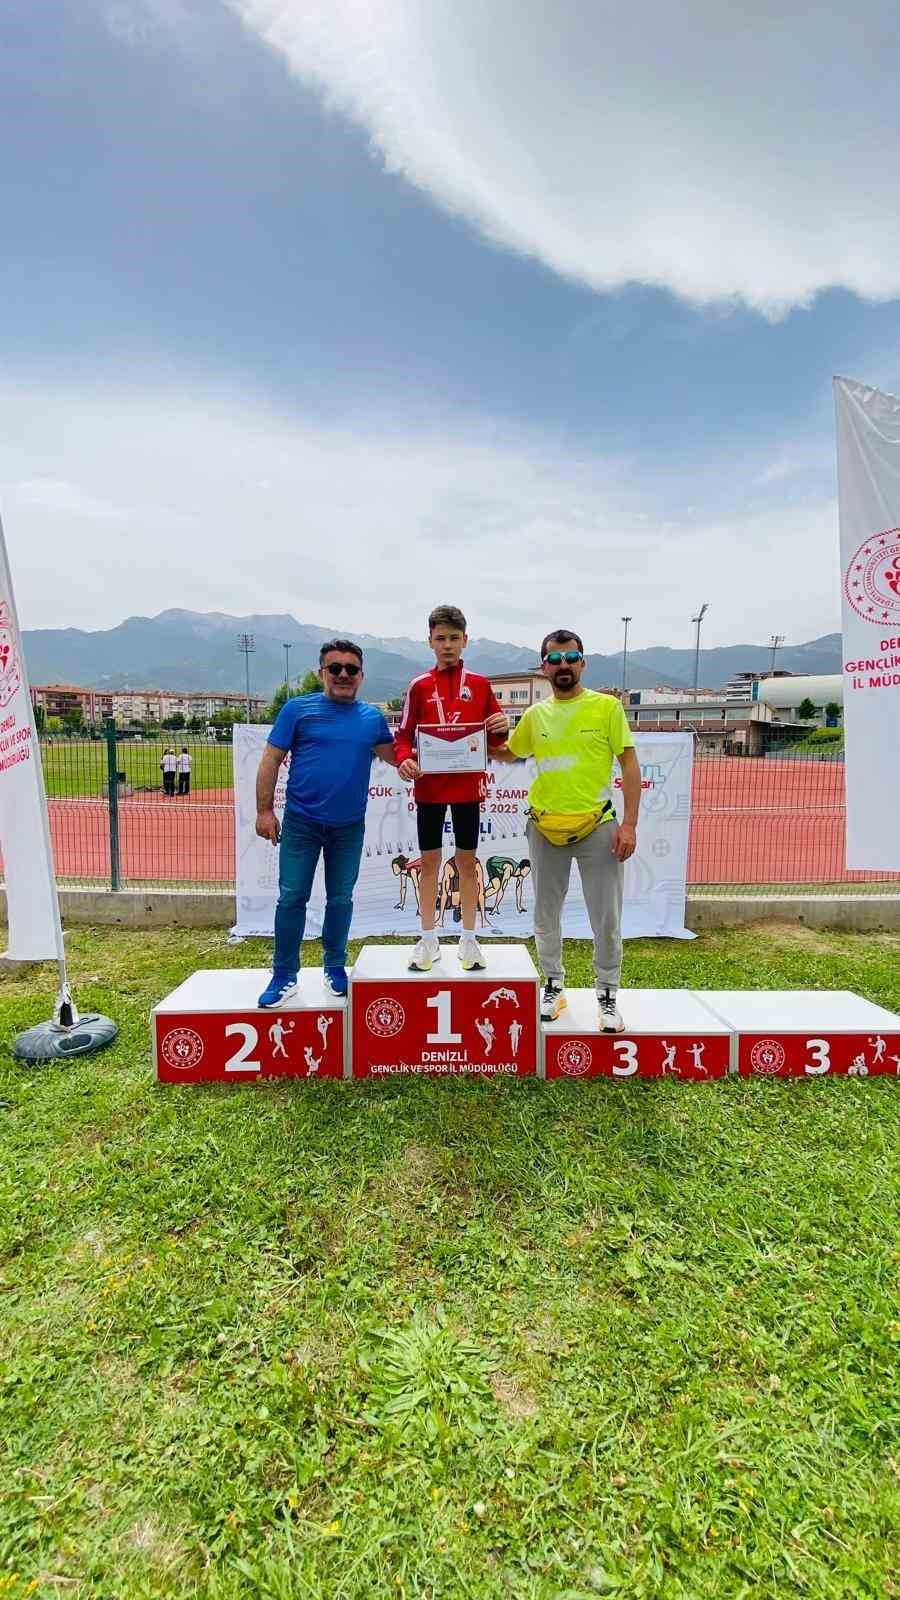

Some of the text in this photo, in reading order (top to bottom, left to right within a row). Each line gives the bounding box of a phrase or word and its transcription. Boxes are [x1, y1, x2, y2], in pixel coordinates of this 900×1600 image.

[845, 654, 900, 673] GENÇLİK
[853, 676, 864, 690] İL
[369, 785, 393, 799] ÇÜK
[495, 788, 528, 801] ŞAMP
[490, 803, 518, 814] 2025
[426, 990, 462, 1044] 1
[224, 1023, 261, 1072] 2
[421, 1049, 468, 1062] DENİZLİ
[612, 1040, 639, 1076] 3
[804, 1039, 831, 1075] 3
[410, 1064, 422, 1073] VE
[423, 1064, 448, 1073] SPOR
[449, 1062, 458, 1073] İL
[459, 1062, 518, 1073] MÜDÜRLÜĞÜ
